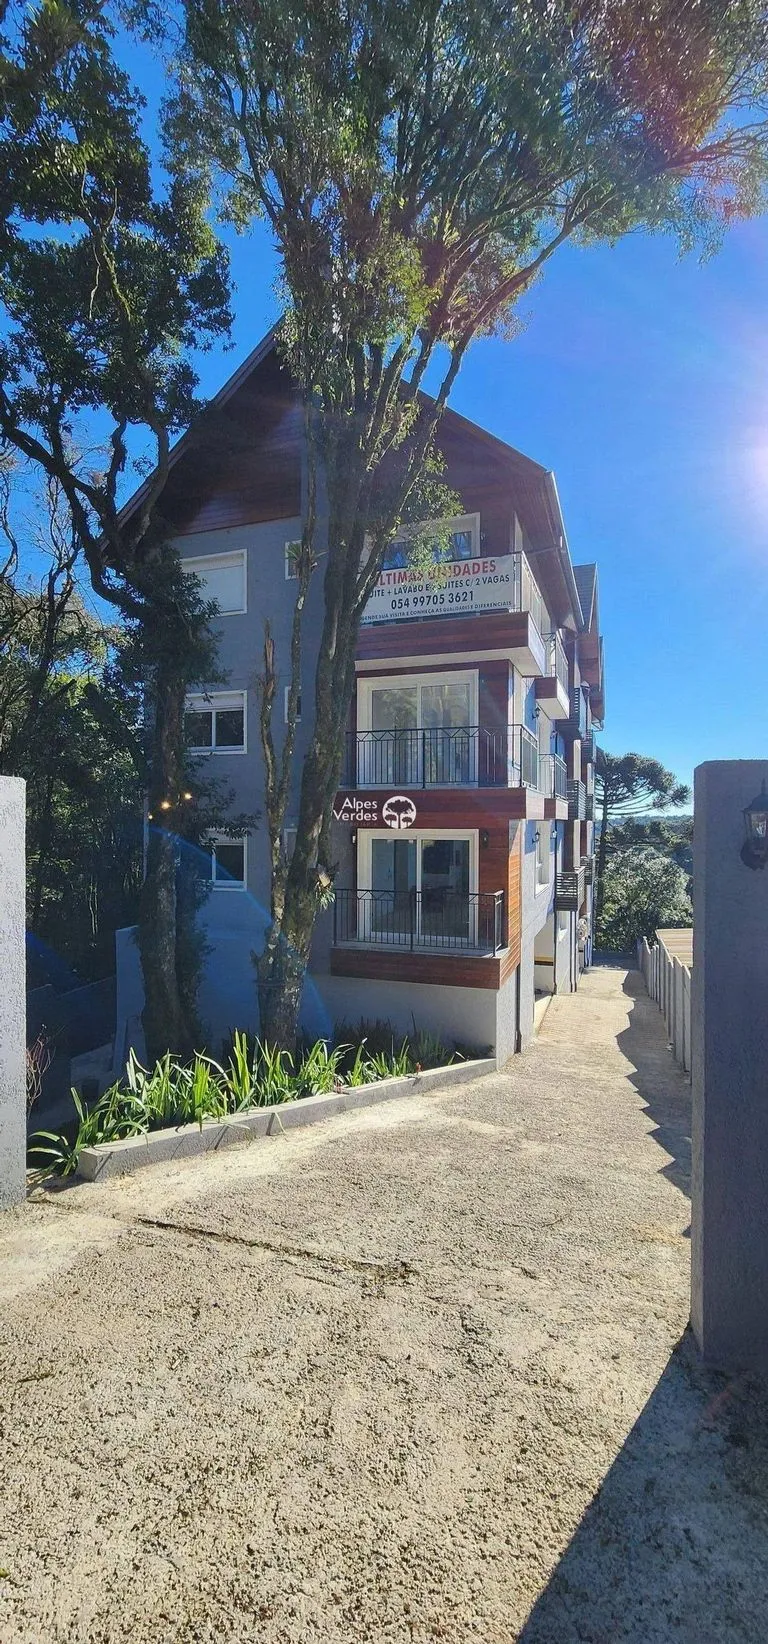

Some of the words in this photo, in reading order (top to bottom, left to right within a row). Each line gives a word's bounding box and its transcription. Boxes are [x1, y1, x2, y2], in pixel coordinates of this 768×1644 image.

[369, 588, 384, 598] UITE
[394, 585, 423, 595] LAVABO
[437, 580, 463, 590] SUITES
[475, 578, 480, 586] 2
[482, 574, 510, 585] VAGAS
[376, 570, 423, 587] LTIMAS
[391, 598, 410, 609] 054
[413, 594, 445, 607] 99705
[448, 591, 474, 604] 3621
[475, 601, 512, 609] DIFERENCIAIS
